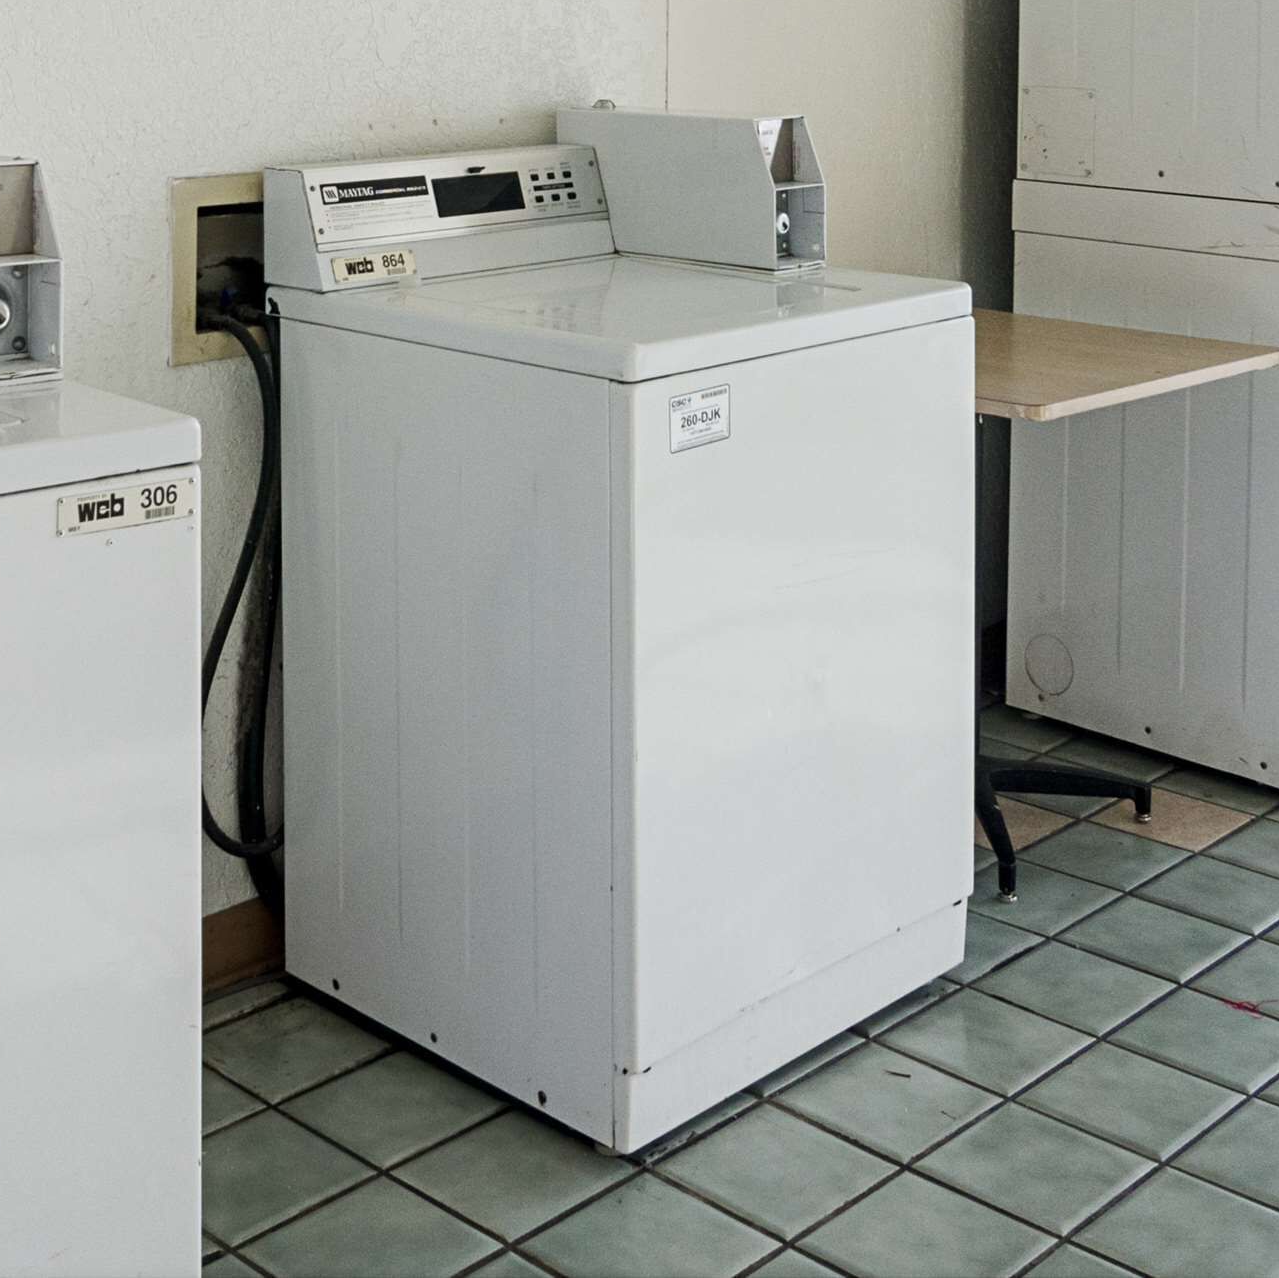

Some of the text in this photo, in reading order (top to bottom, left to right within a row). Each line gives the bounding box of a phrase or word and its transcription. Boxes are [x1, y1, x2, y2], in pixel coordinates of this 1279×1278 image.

[339, 187, 374, 198] MAYTAG
[381, 253, 405, 268] 864
[681, 408, 720, 428] 260-DJK
[140, 484, 178, 508] 306
